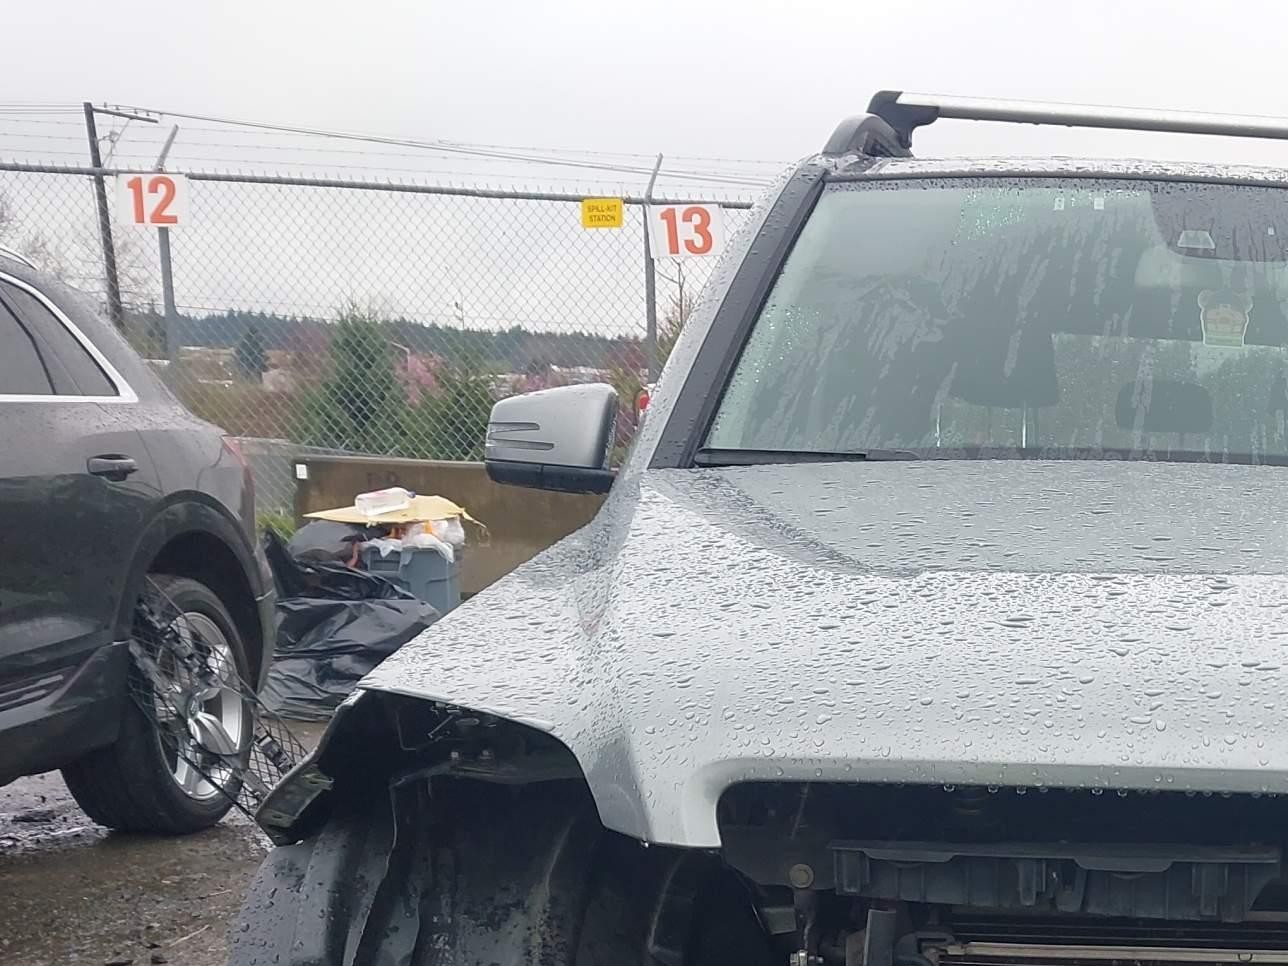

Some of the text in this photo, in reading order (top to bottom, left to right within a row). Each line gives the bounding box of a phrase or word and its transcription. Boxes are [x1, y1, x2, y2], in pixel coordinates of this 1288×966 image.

[127, 176, 178, 224] 12
[589, 214, 616, 222] STATION
[660, 206, 713, 255] 13
